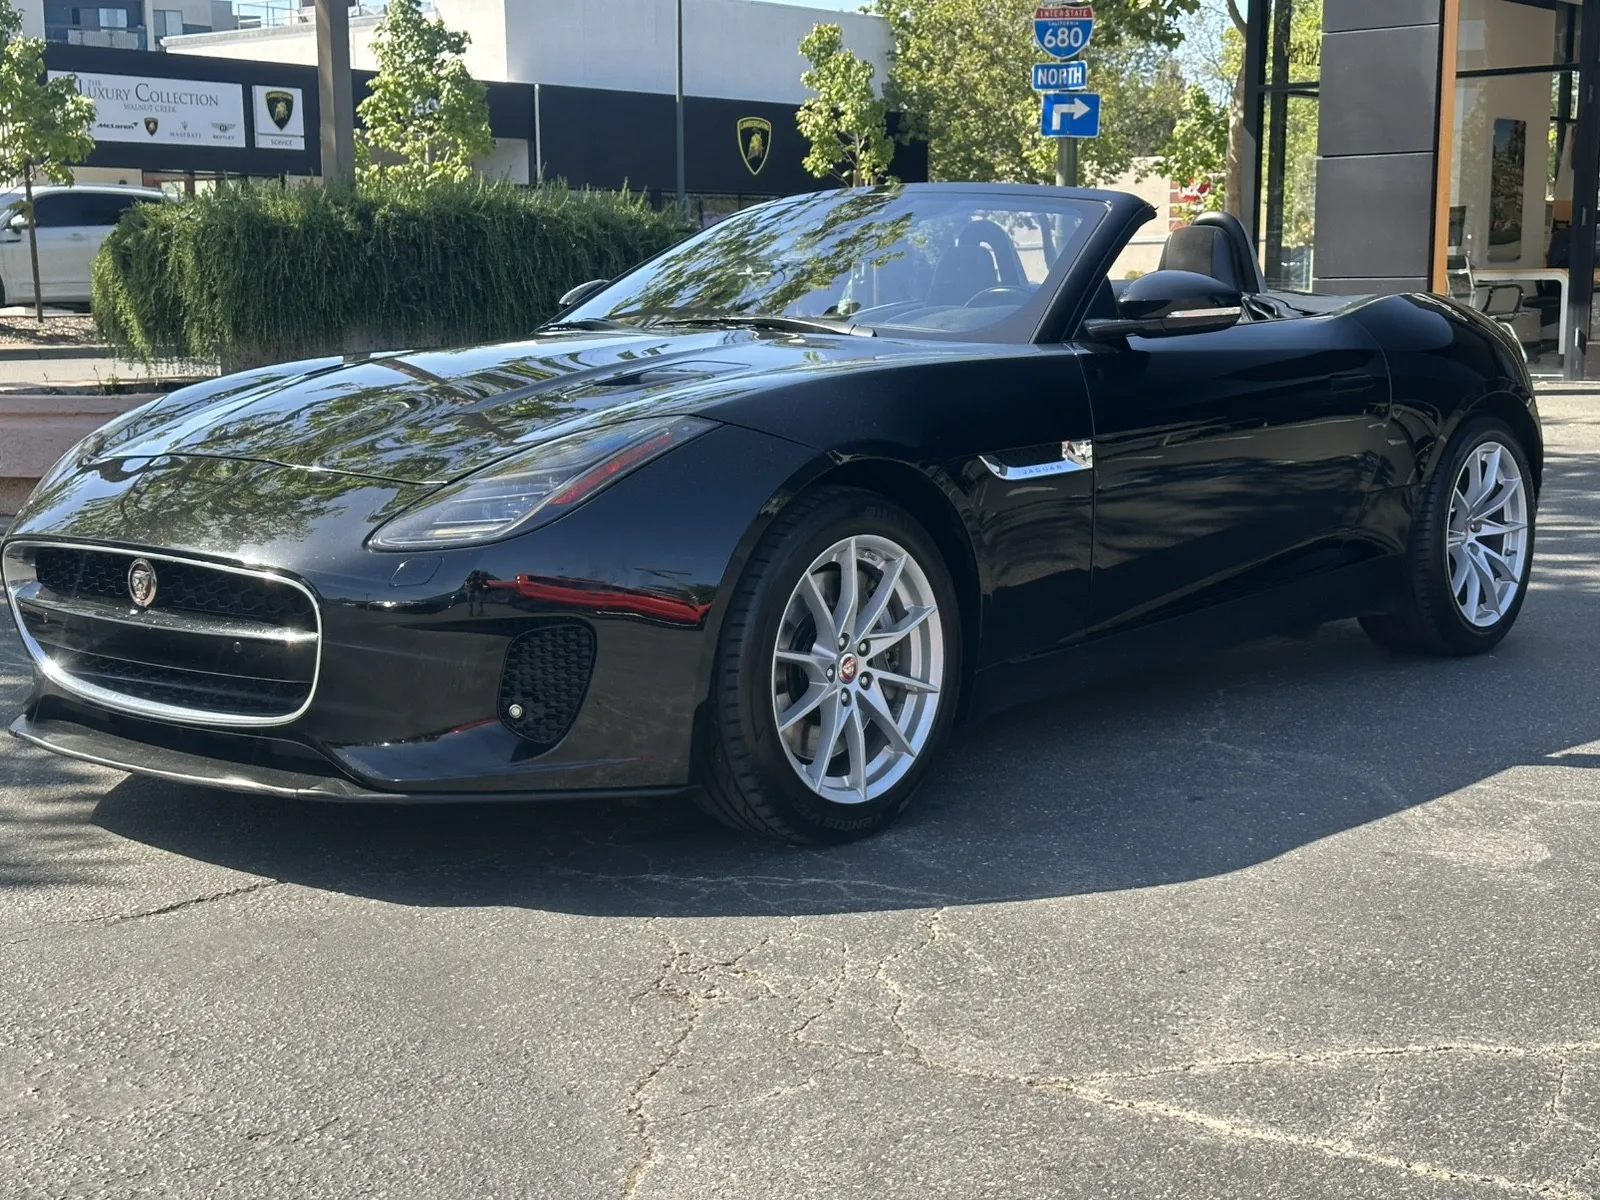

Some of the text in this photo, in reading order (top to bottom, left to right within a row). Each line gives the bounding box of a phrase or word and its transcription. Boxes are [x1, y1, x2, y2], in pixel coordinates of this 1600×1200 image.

[1040, 9, 1087, 17] INTERSTATE
[1044, 27, 1083, 48] 680
[1037, 66, 1082, 86] NORTH
[88, 79, 101, 87] THE
[135, 82, 219, 107] COLLECTION
[123, 103, 177, 113] WALNUT CREEK
[96, 122, 135, 130] McLaren
[270, 139, 293, 147] SERVICE
[1022, 465, 1063, 475] JAGUAR
